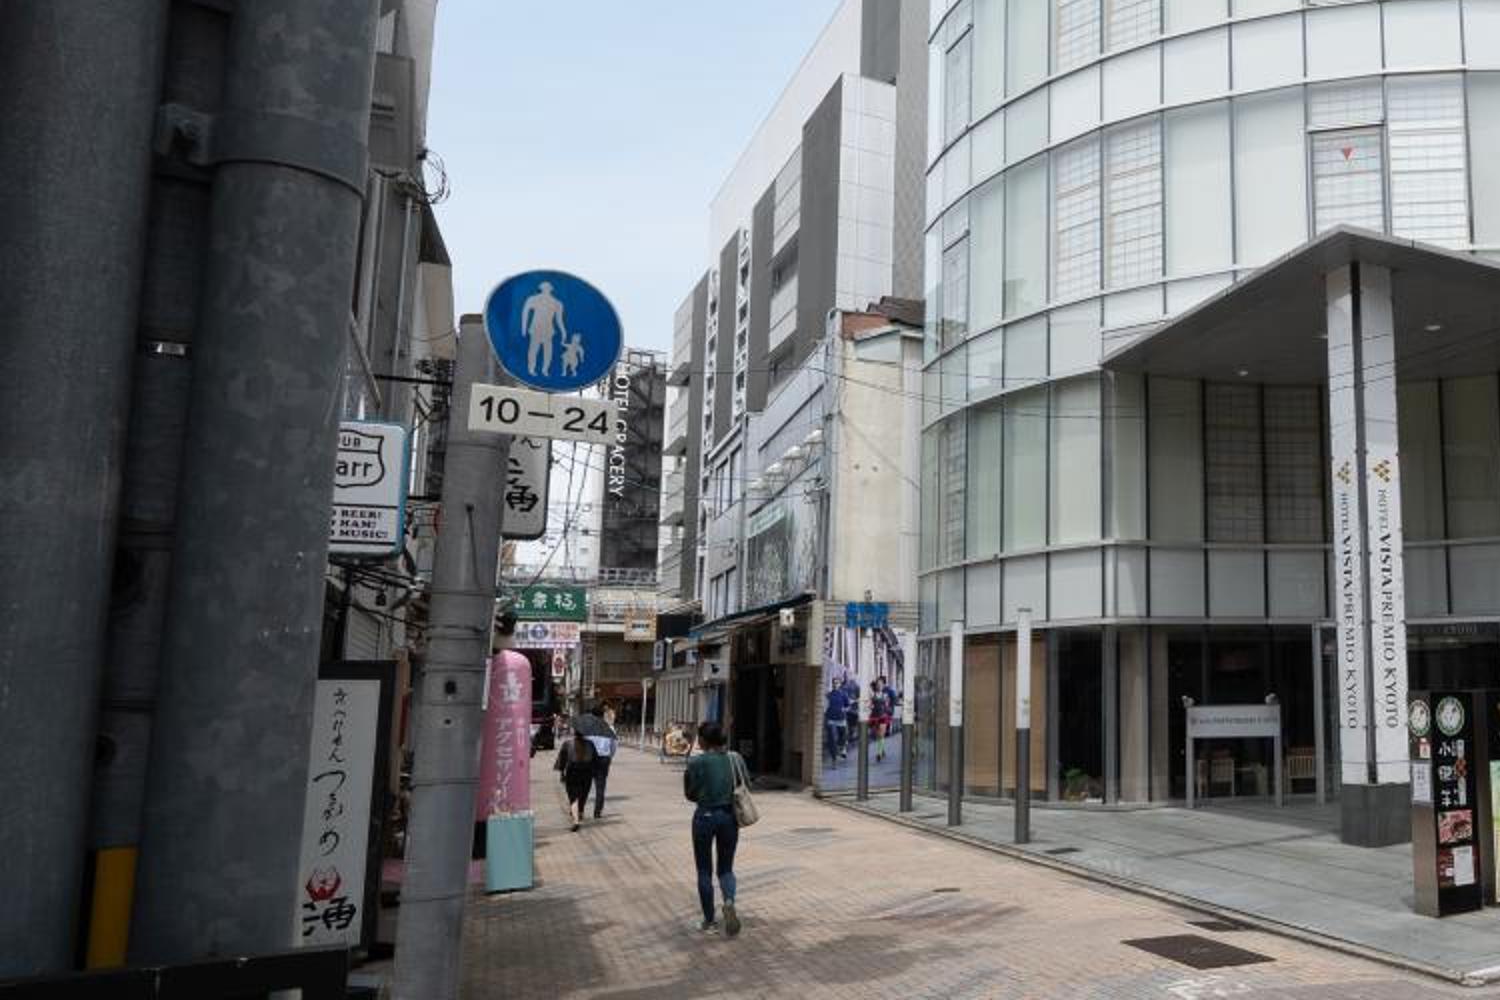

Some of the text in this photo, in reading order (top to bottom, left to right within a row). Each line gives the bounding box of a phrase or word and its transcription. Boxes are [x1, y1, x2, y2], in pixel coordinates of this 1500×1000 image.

[336, 461, 373, 478] arr
[1342, 534, 1353, 591] VISTA
[1378, 533, 1392, 592] VISTA
[1343, 592, 1356, 663] PREMIO
[1381, 591, 1395, 661] PREMIO
[1346, 668, 1358, 729] KYOTO
[1384, 666, 1399, 729] KYOTO
